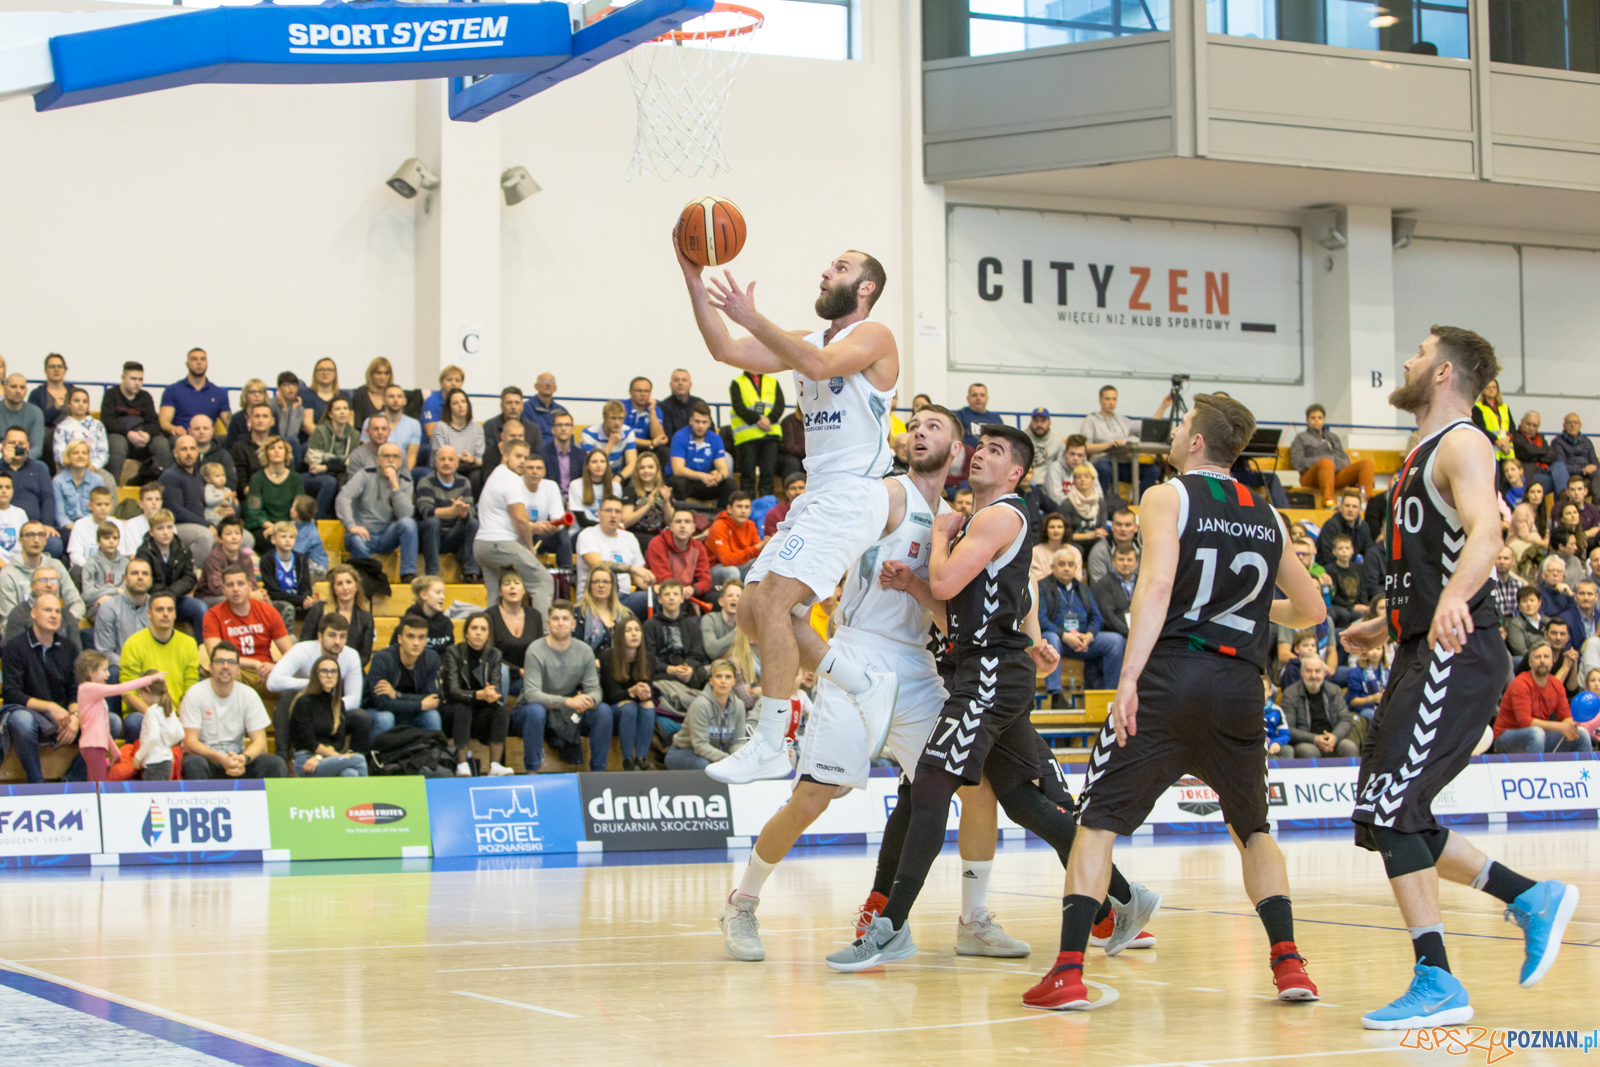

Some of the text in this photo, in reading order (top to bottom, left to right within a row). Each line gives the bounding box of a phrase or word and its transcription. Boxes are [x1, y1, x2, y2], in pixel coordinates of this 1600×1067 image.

[289, 16, 509, 50] SPORT SYSTEM
[977, 256, 1230, 315] CITYZEN
[1057, 311, 1100, 325] WIĘCEJ
[1131, 316, 1161, 327] KLUB
[1168, 317, 1230, 331] SPORTOWY
[462, 333, 479, 354] C
[1370, 370, 1383, 388] B
[1196, 518, 1276, 543] JANKOWSKI
[778, 534, 805, 561] 9
[1183, 548, 1269, 635] 12
[227, 624, 265, 637] ROCKETS
[239, 635, 255, 655] 13
[166, 796, 231, 807] fundacja
[588, 787, 728, 820] drukma
[289, 805, 335, 822] Frytki
[348, 808, 404, 817] FARM FRITES
[170, 807, 233, 844] PBG
[474, 822, 541, 844] HOTEL
[593, 819, 729, 834] DRUKARNIA SKOCZYŃSKI
[477, 842, 543, 853] POZNAŃSKI
